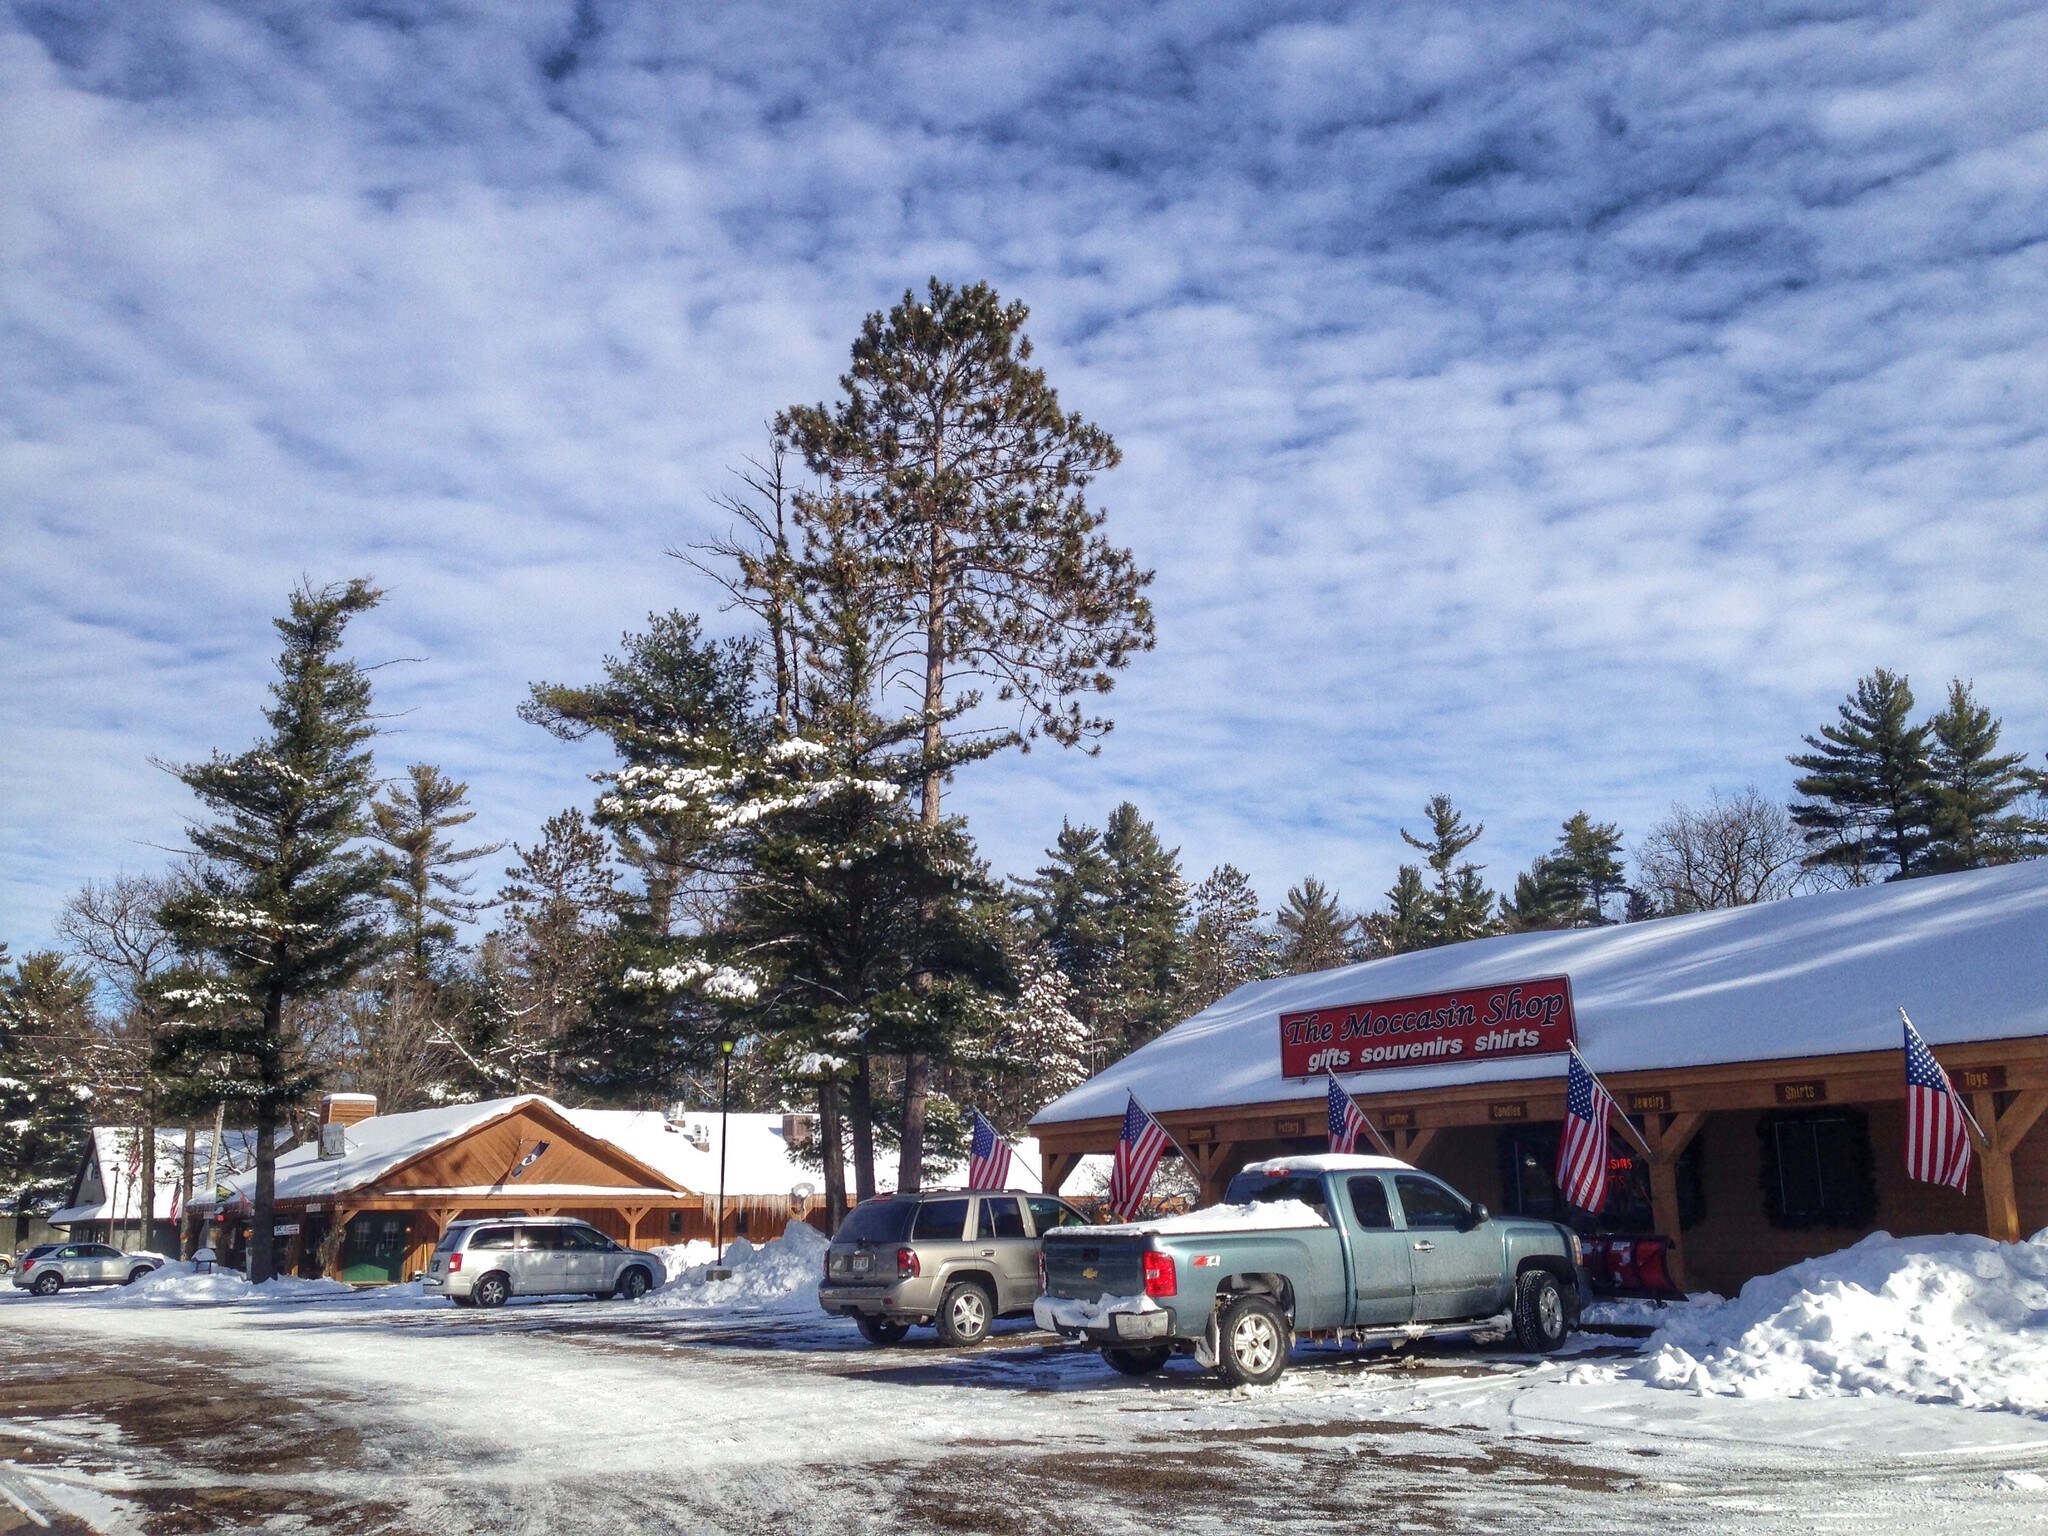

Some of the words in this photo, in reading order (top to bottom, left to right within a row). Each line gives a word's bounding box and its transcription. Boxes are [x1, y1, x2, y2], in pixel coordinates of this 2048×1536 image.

[1284, 1016, 1333, 1046] The
[1340, 999, 1477, 1040] Moccasin
[1482, 988, 1565, 1026] Shop
[1308, 1047, 1351, 1072] gifts
[1360, 1036, 1463, 1064] souvenirs
[1474, 1029, 1540, 1052] shirts
[1963, 1070, 1989, 1088] Toys
[1784, 1084, 1816, 1100] Shirts
[1632, 1095, 1665, 1110] Jewelry
